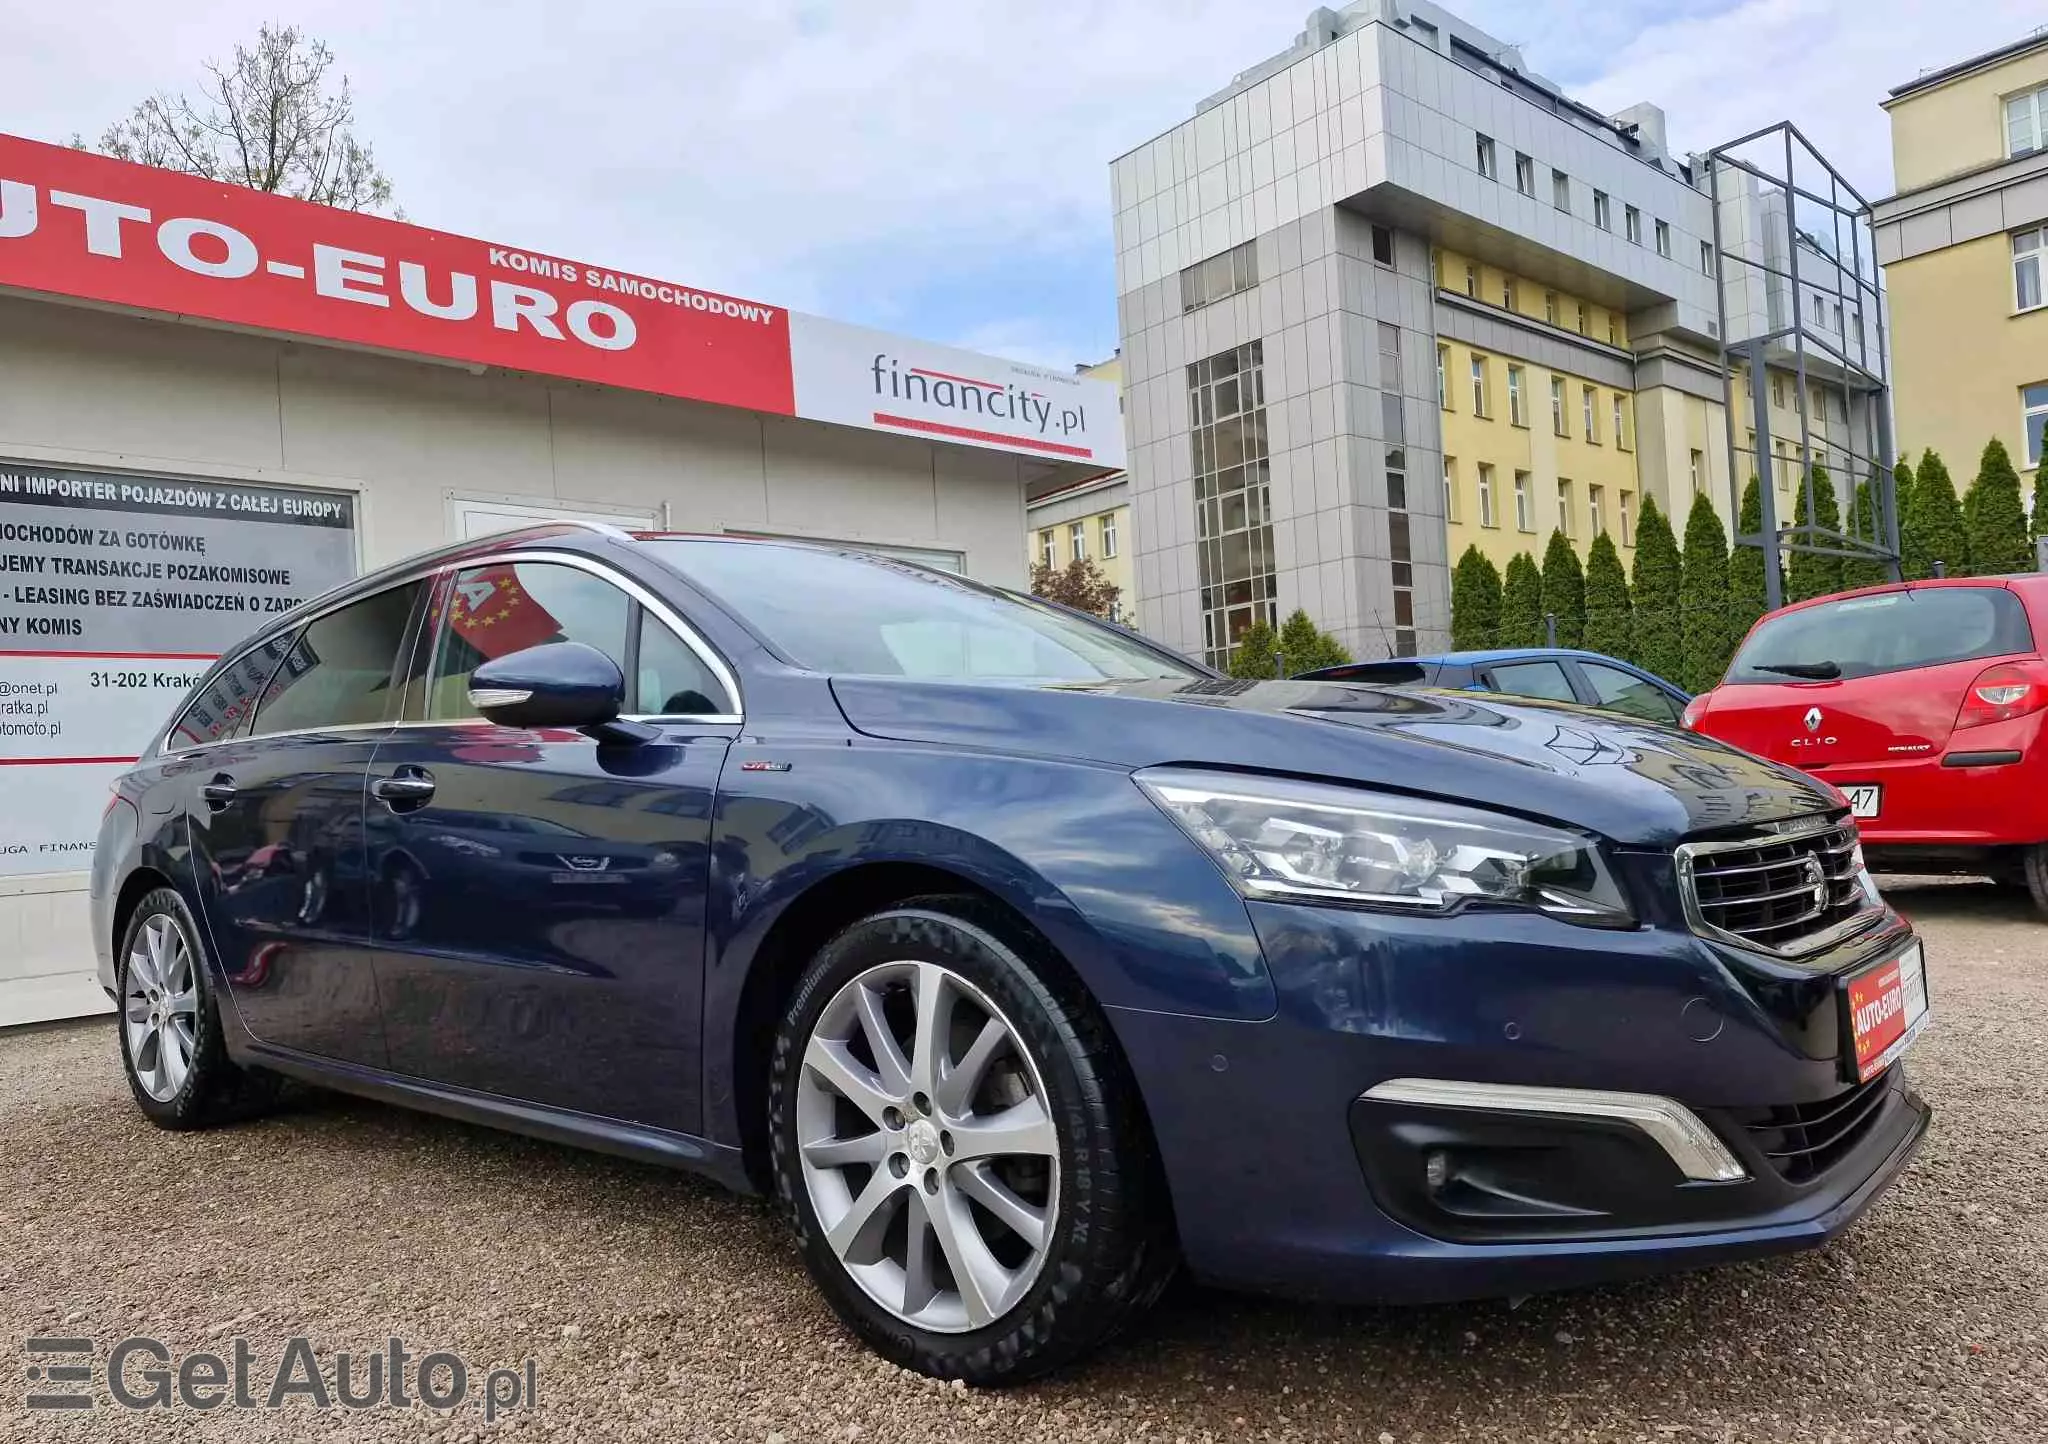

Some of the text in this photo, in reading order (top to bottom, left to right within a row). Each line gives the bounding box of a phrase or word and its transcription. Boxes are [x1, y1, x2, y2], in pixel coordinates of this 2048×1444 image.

[489, 247, 774, 325] KOMIS SAMOCHODOWY
[870, 353, 1086, 436] financity.pl
[26, 476, 117, 500] IMPORTER
[121, 484, 212, 509] POJAZDÓW
[215, 492, 227, 510] Z
[230, 494, 279, 513] CAŁEJ
[283, 498, 342, 519] EUROPY
[0, 523, 206, 556] OCHODÓW ZA GOTÓWKĘ
[51, 557, 162, 579] TRANSAKCJE
[167, 563, 291, 586] POZAKOMISOWE
[14, 585, 90, 605] LEASING
[95, 589, 128, 607] BEZ
[132, 588, 245, 612] ZAŚWIADCZEŃ
[250, 596, 260, 612] O
[26, 617, 82, 635] KOMIS
[90, 672, 148, 688] 31-202
[1, 699, 49, 717] ratka.pl
[0, 720, 61, 738] tomoto.pl
[1791, 736, 1838, 747] CLIO
